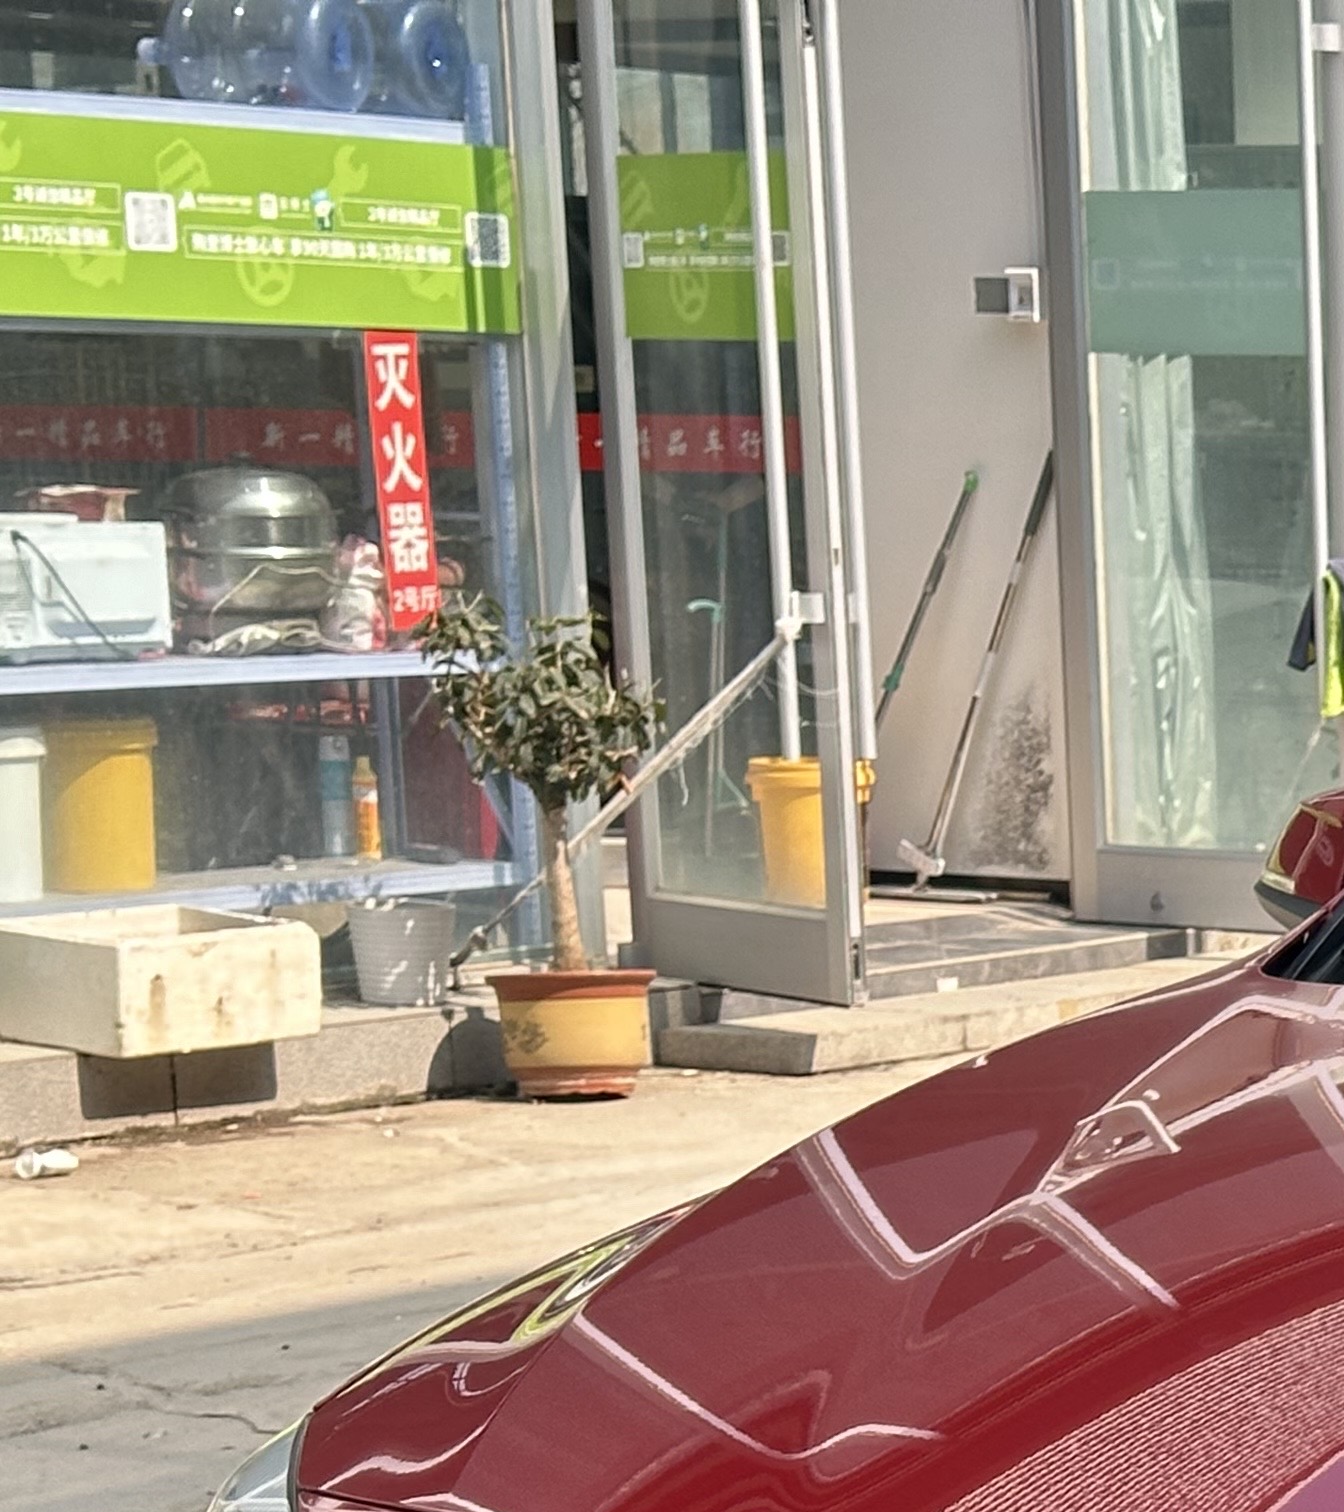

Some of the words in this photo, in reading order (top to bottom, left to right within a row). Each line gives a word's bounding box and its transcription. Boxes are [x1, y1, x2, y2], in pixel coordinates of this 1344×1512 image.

[370, 343, 429, 572] 灭火器
[392, 585, 441, 612] 2号厅
